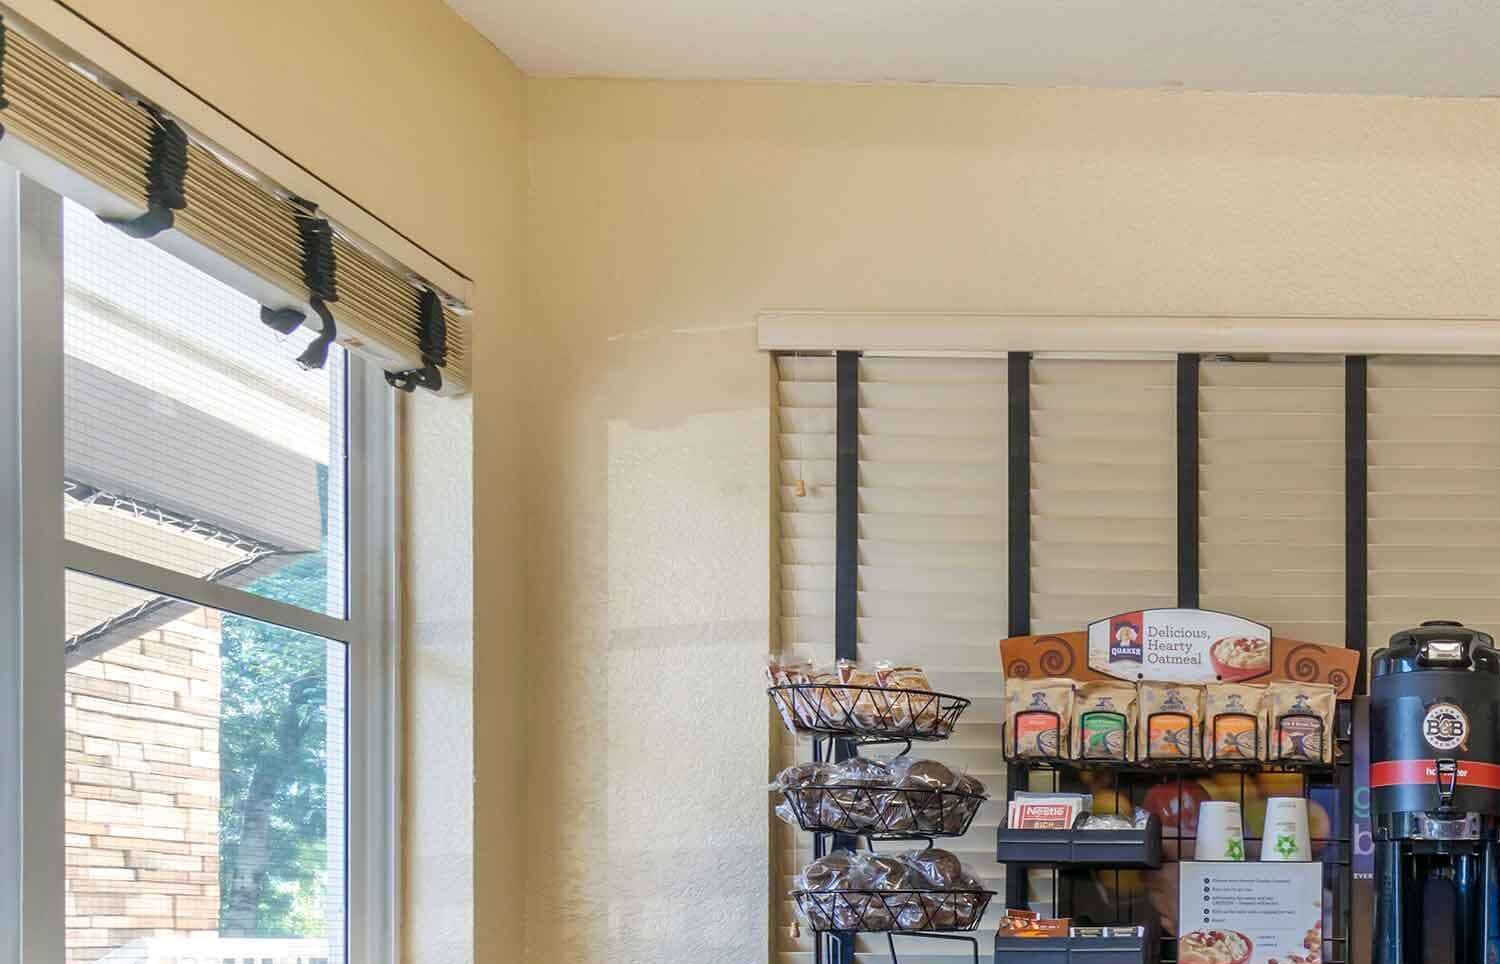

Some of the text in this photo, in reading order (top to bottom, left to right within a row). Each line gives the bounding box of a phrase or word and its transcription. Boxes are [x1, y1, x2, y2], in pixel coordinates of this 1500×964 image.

[1147, 625, 1211, 640] Delicious,
[1111, 647, 1142, 656] QUAKER
[1147, 640, 1193, 654] Hearty
[1147, 652, 1202, 665] Oatmeal
